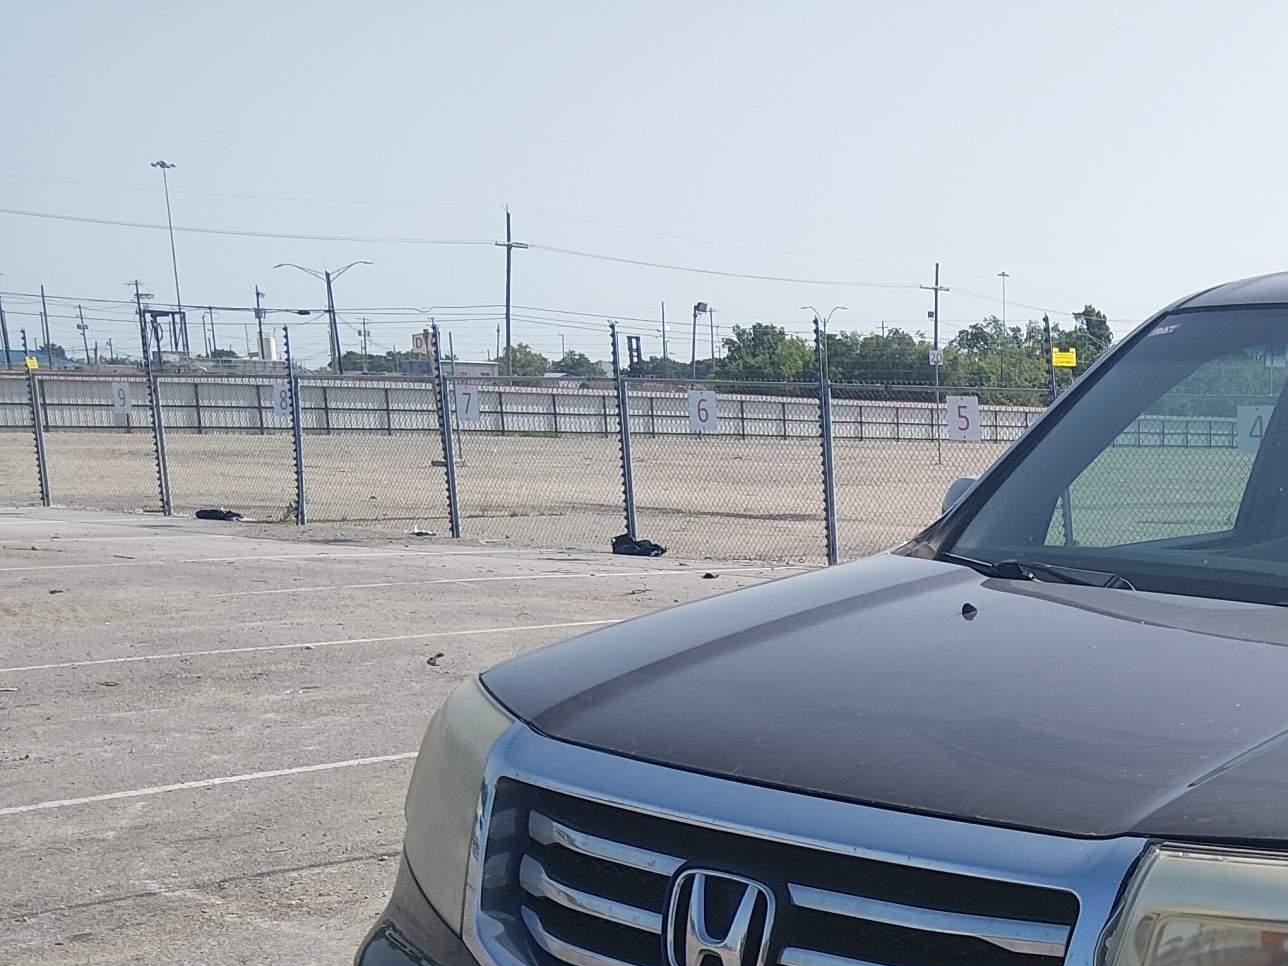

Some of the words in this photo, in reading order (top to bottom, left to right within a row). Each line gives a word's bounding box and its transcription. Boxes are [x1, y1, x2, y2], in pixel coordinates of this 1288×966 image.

[930, 352, 943, 365] 20
[118, 388, 126, 409] 9
[280, 390, 288, 409] 8
[462, 392, 472, 414] 7
[697, 398, 709, 424] 6
[957, 404, 970, 432] 5
